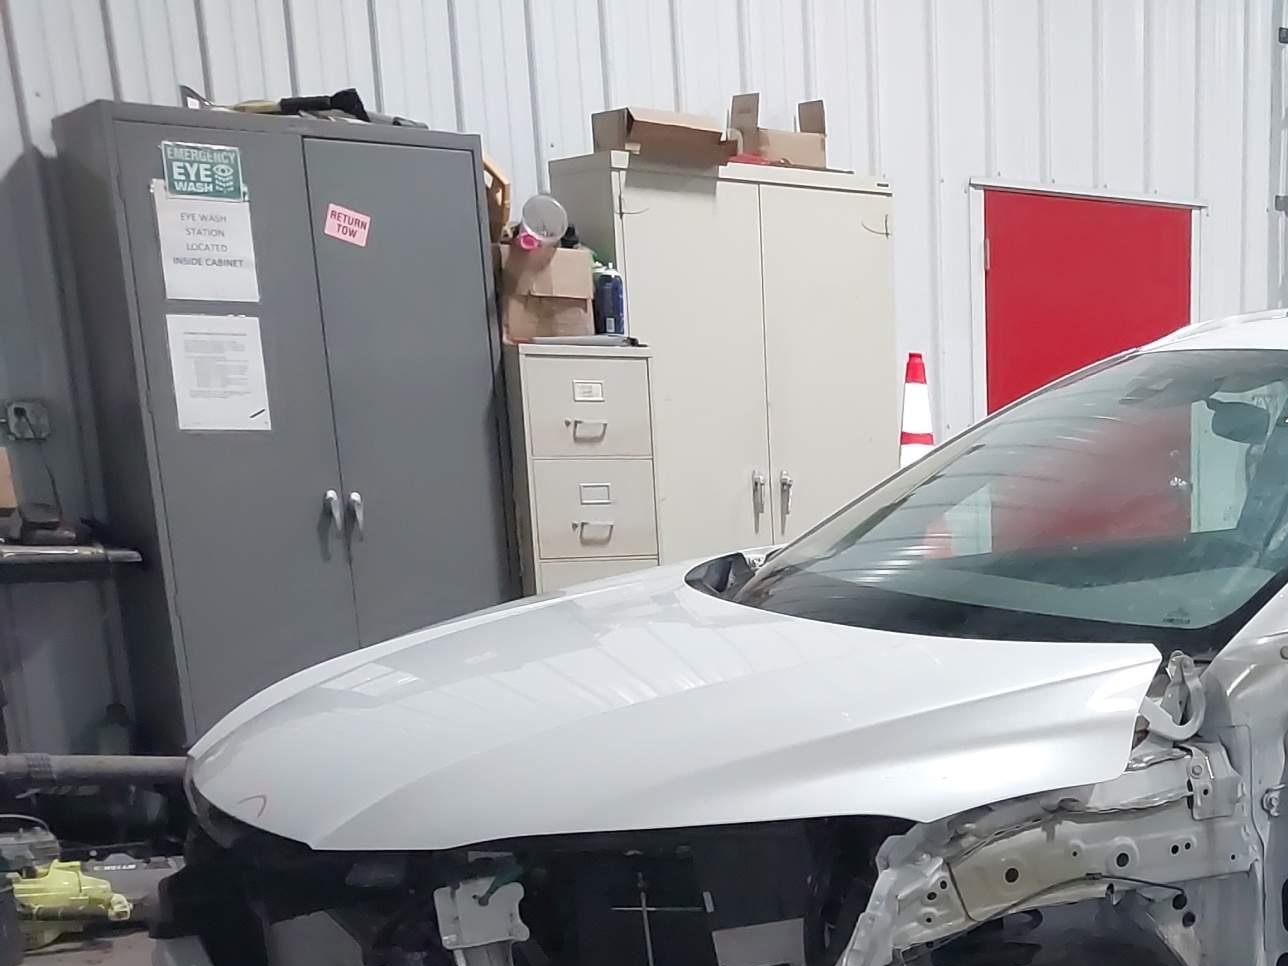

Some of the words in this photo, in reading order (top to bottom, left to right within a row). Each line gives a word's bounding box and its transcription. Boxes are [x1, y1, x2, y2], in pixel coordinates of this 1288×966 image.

[167, 146, 236, 164] EMERGENCY
[172, 161, 213, 182] EYE
[174, 181, 214, 193] WASH
[180, 211, 199, 222] EYE
[200, 212, 227, 223] WASH
[330, 210, 368, 231] RETURN
[185, 227, 225, 238] STATION
[337, 223, 358, 239] TOW
[186, 243, 229, 253] LOCATED
[173, 256, 203, 267] INSIDE
[205, 258, 244, 268] CABINET
